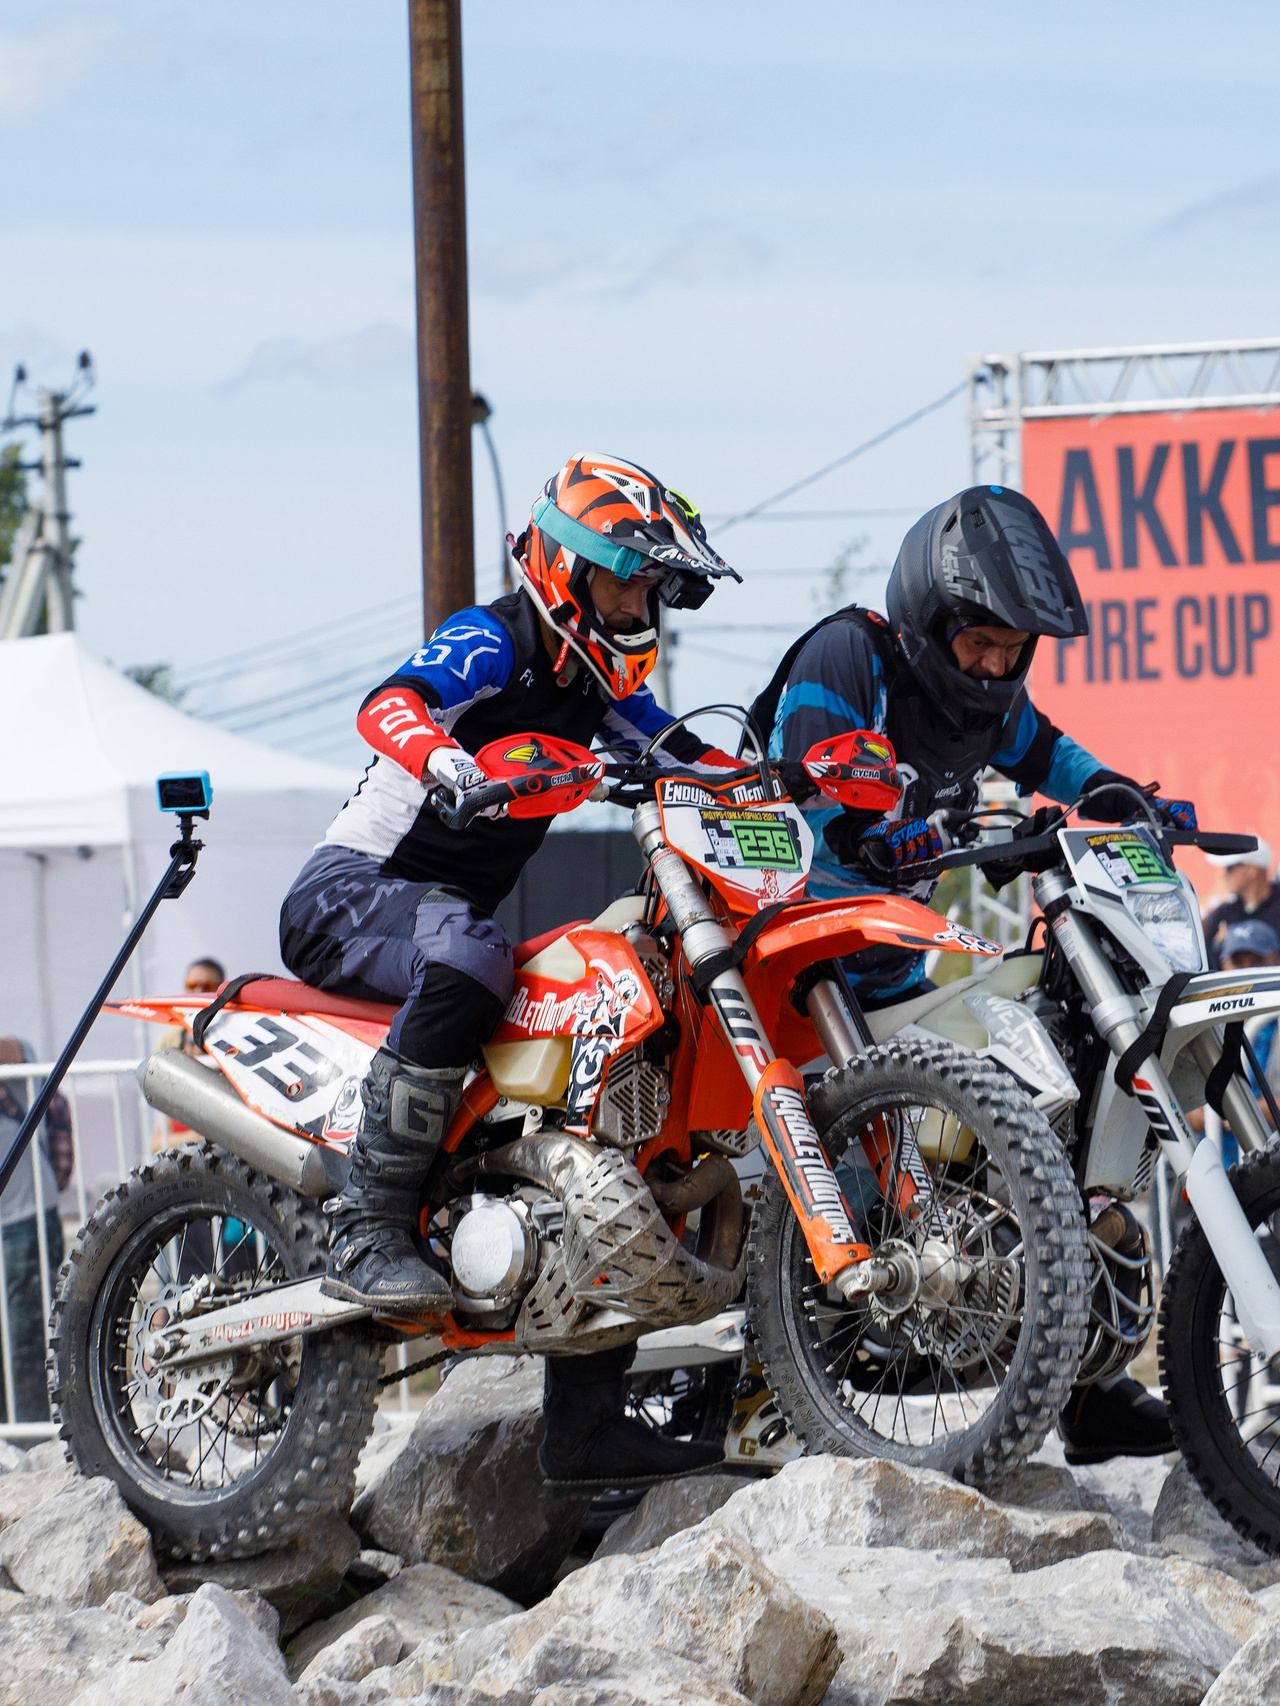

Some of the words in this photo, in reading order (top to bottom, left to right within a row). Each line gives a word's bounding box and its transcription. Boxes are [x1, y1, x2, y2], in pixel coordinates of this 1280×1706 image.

[1174, 593, 1272, 678] CUP
[368, 696, 436, 749] FOX
[851, 768, 881, 780] CYCRA
[738, 829, 795, 861] 235
[1208, 997, 1255, 1013] MOTUL
[213, 1017, 344, 1103] 33
